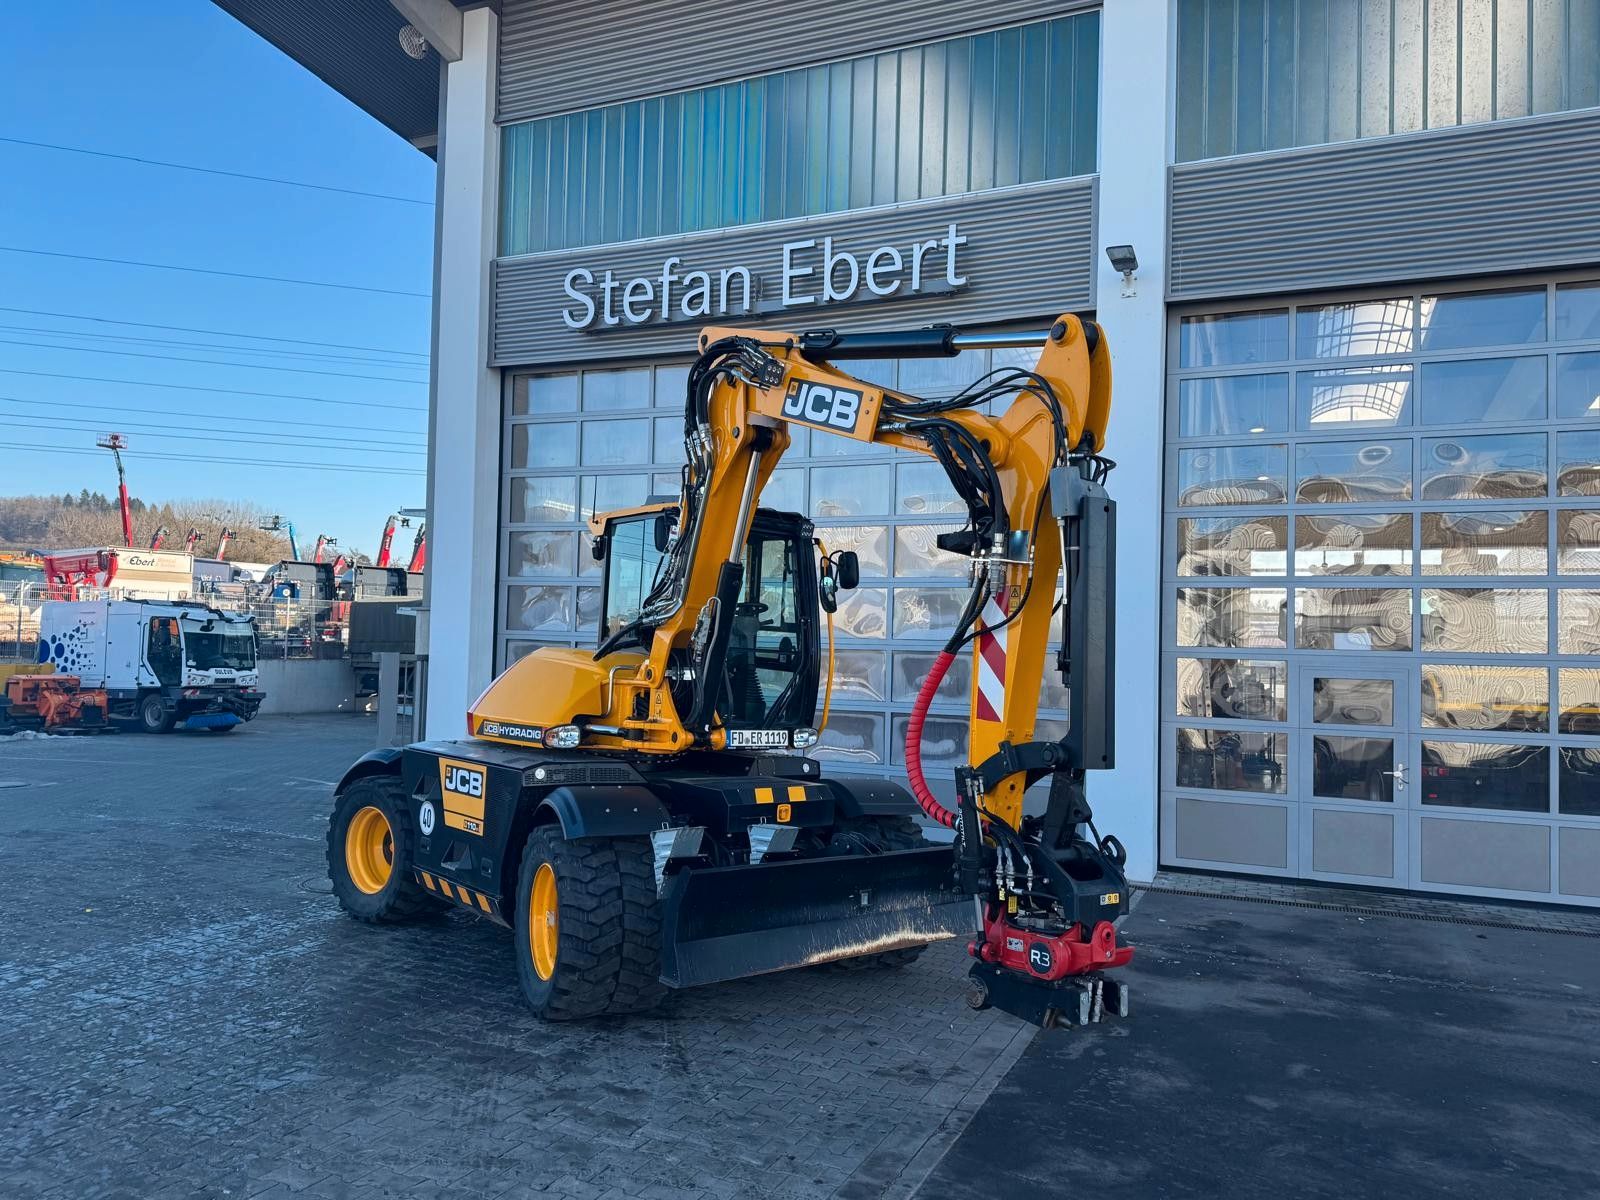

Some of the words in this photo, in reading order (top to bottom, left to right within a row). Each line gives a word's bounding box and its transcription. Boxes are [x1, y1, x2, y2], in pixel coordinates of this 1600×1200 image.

[562, 256, 752, 328] Stefan
[782, 224, 969, 307] Ebert
[784, 383, 859, 429] JCB
[129, 556, 155, 566] Ebert
[484, 723, 499, 735] JCB
[499, 725, 542, 740] HYDRADIG
[731, 731, 744, 745] FD
[750, 731, 763, 745] ER
[764, 731, 787, 745] 1119
[445, 767, 482, 797] JCB
[422, 807, 432, 829] 40
[1030, 949, 1050, 967] R3
